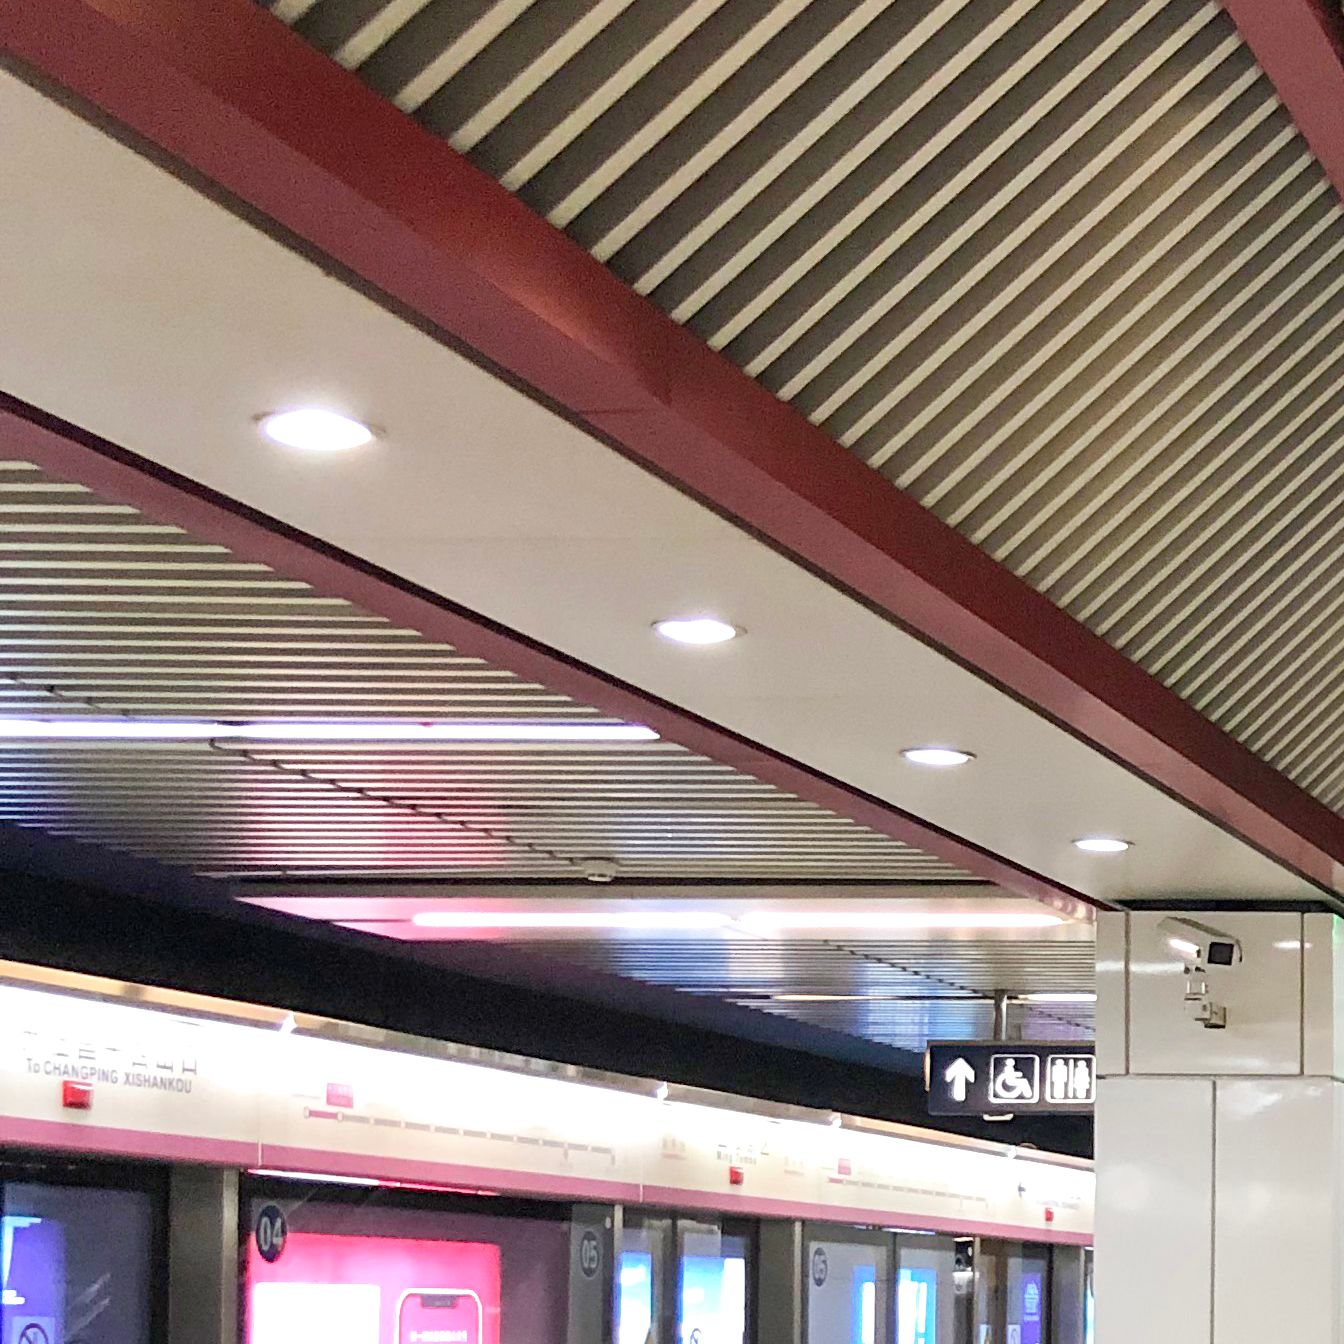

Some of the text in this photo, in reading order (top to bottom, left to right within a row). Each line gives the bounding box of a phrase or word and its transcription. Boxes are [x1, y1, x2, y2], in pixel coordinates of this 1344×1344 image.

[27, 1058, 192, 1094] To CHANGPING XISHANKOU
[259, 1217, 283, 1251] 04
[580, 1240, 598, 1269] 05
